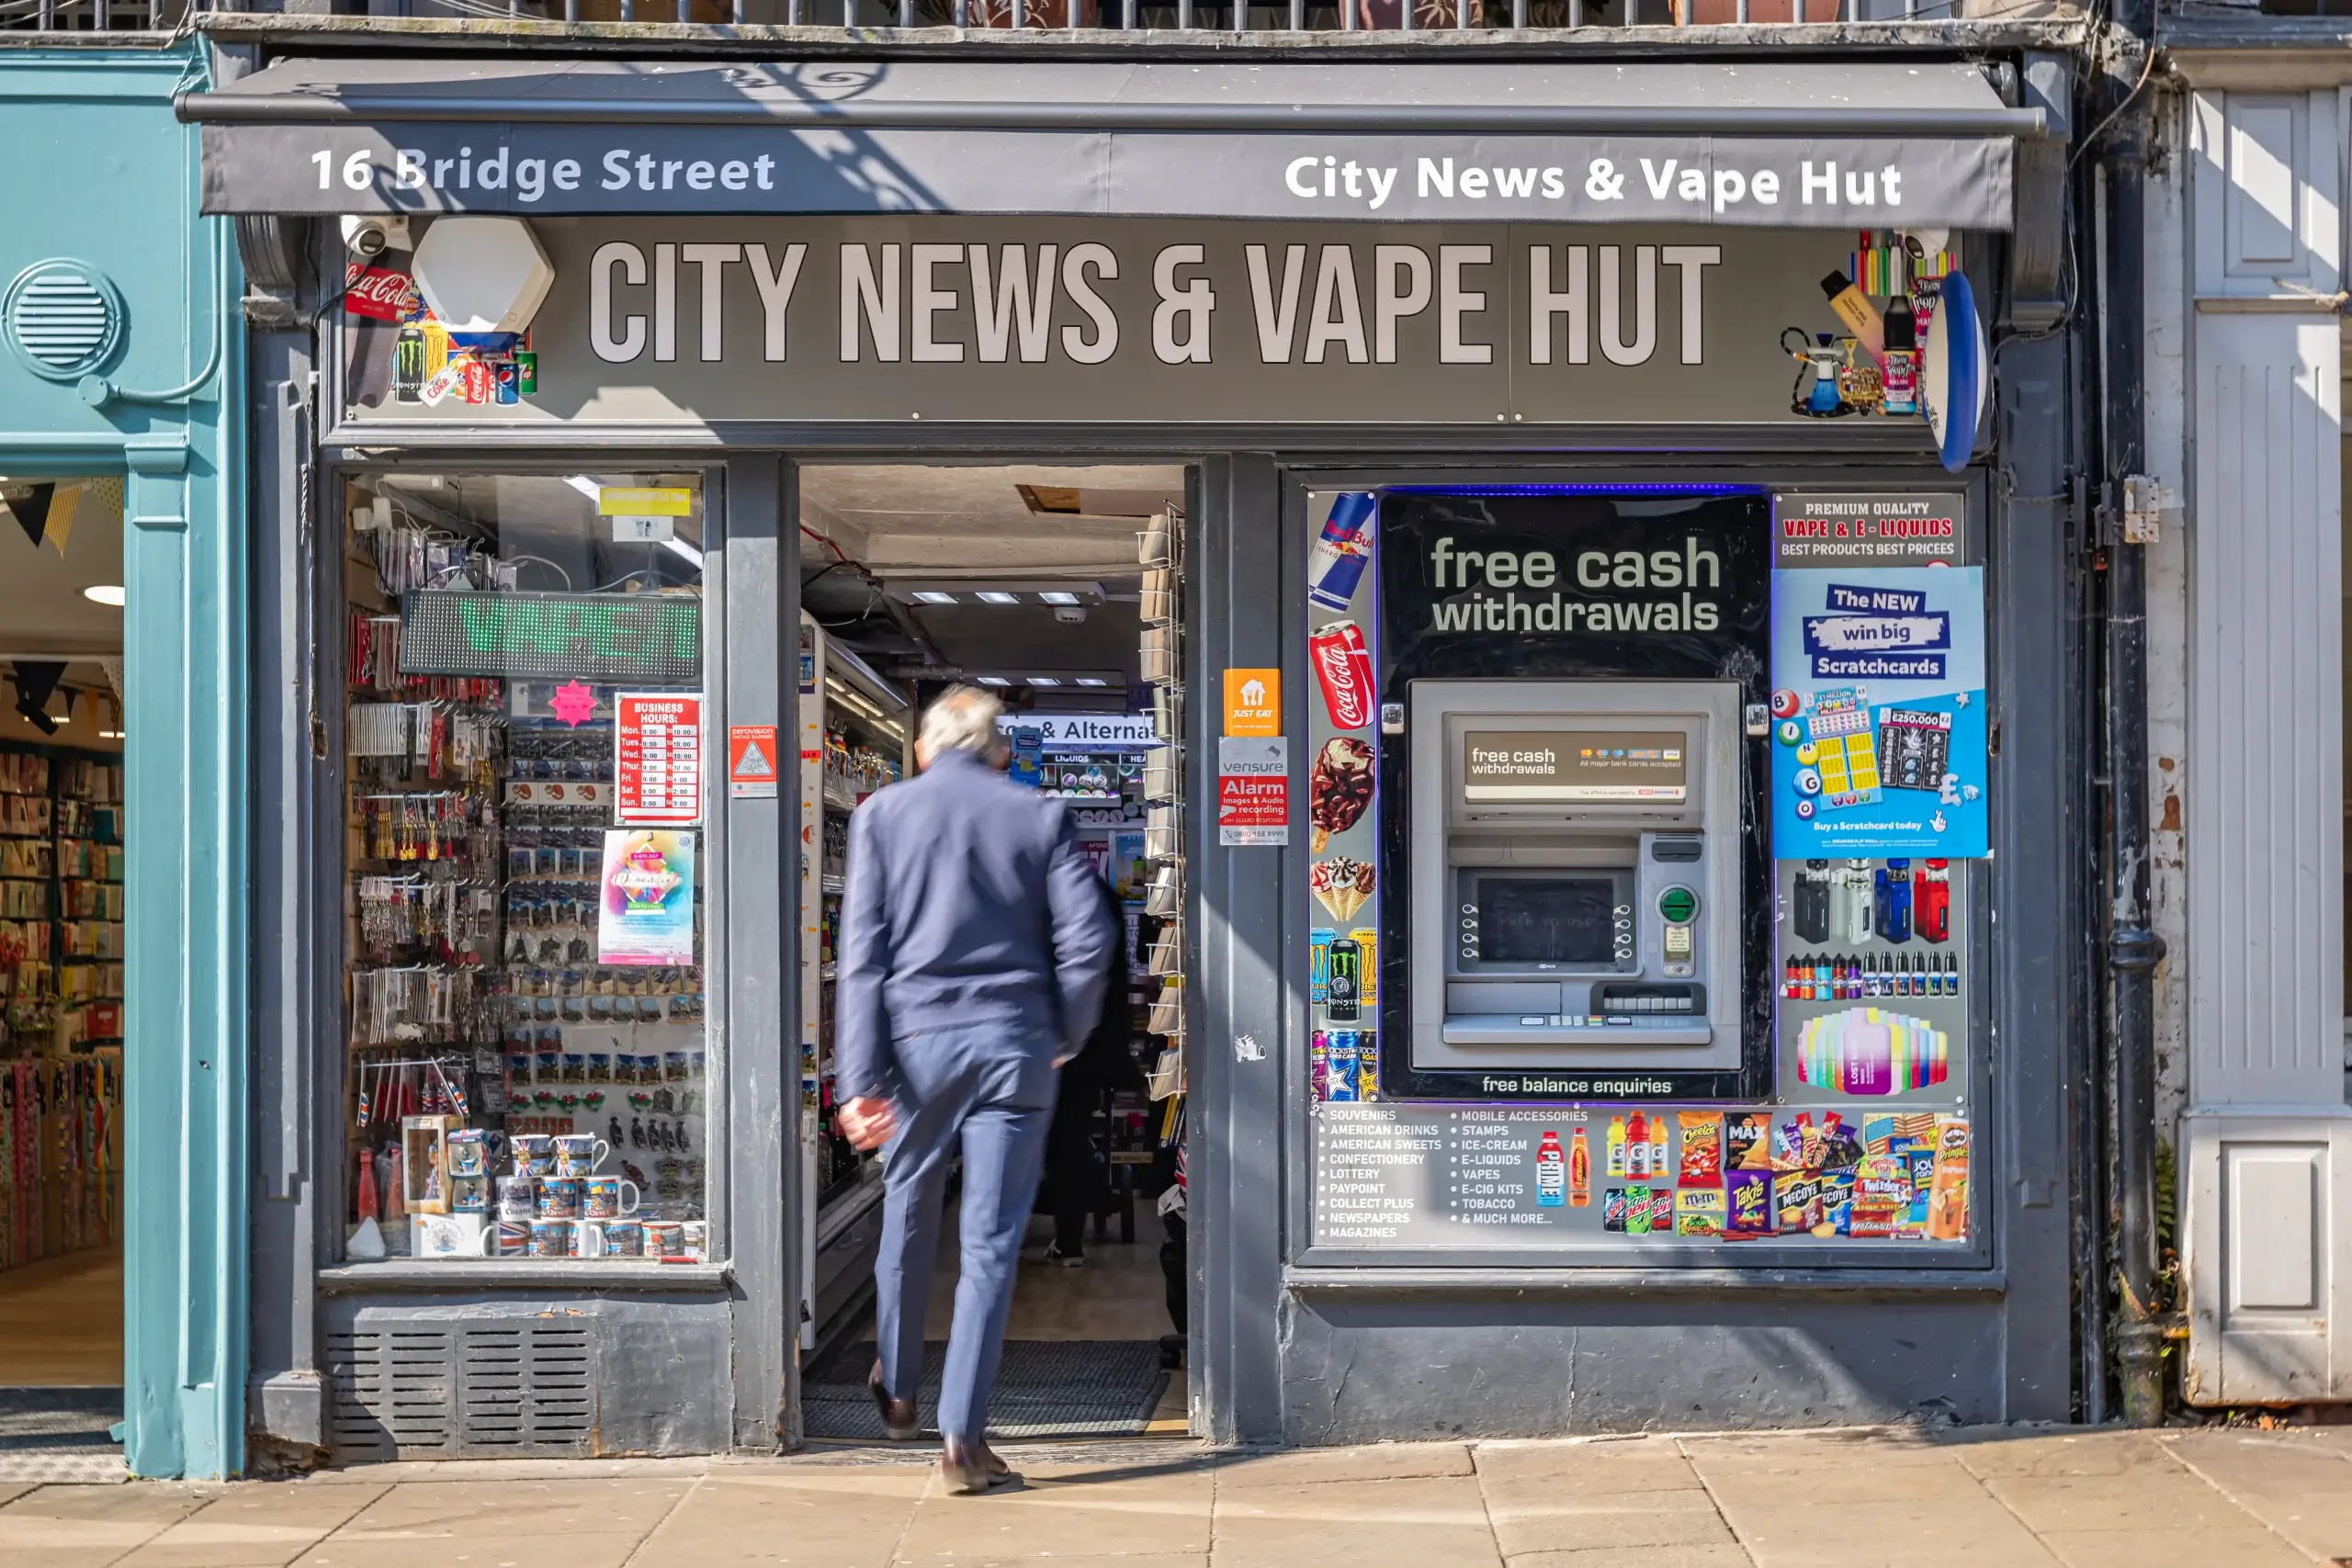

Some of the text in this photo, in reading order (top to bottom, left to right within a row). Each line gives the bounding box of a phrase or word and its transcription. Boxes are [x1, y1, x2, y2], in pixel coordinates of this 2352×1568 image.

[310, 148, 776, 202] 16 Bridge Street
[1285, 156, 1902, 214] City News & Vape Hut
[589, 240, 1723, 367] CITY NEWS & VAPE HUT
[427, 378, 450, 399] Coke
[1805, 502, 1929, 515] PREMIUM QUALITY
[1325, 519, 1374, 549] Red Bull
[1782, 518, 1828, 538] VAPE
[1836, 520, 1849, 538] &
[1855, 518, 1866, 538] E
[1879, 518, 1952, 539] LIQUIDS
[1781, 543, 1954, 556] BEST PRODUCTS BEST PRICEES
[1430, 536, 1720, 589] free cash
[1834, 589, 1919, 612] The NEW
[1431, 592, 1719, 631] withdrawals
[1843, 624, 1911, 642] win big
[1817, 657, 1939, 675] Scratchcards
[635, 704, 683, 712] BUSINESS
[1773, 695, 1784, 709] B
[641, 715, 678, 723] HOURS:
[1892, 713, 1939, 726] £250,000
[621, 726, 639, 734] Mon.
[1042, 721, 1056, 739] &
[1803, 744, 1811, 752] N
[1472, 748, 1555, 762] free cash
[1224, 761, 1283, 773] verisure
[1472, 762, 1555, 774] withdrawals
[1589, 760, 1610, 768] major
[1649, 760, 1680, 768] accepted
[1224, 780, 1283, 795] Alarm
[1805, 777, 1818, 790] G
[1239, 806, 1283, 815] recording
[1801, 804, 1810, 814] O
[1814, 821, 1832, 832] Buy
[1839, 821, 1894, 831] Scratchcard
[1895, 821, 1922, 832] today
[1850, 1061, 1859, 1085] LOST
[1483, 1076, 1672, 1097] free balance enquiries
[1330, 1111, 1396, 1120] SOUVENIRS
[1462, 1111, 1588, 1121] MOBILE ACCESSORIES
[1330, 1125, 1439, 1135] AMERICAN DRINKS
[1462, 1126, 1509, 1135] STAMPS
[1682, 1123, 1716, 1145] Cheetos
[1729, 1126, 1766, 1140] MAX
[1330, 1140, 1442, 1150] AMERICAN SWEETS
[1462, 1141, 1527, 1150] ICE-CREAM
[1330, 1155, 1425, 1165] CONFECTIONERY
[1462, 1156, 1521, 1166] E-LIQUIDS
[1938, 1146, 1968, 1164] Pringles
[1330, 1169, 1380, 1179] LOTTERY
[1463, 1170, 1500, 1179] VAPES
[1541, 1151, 1560, 1198] PRIME
[1330, 1184, 1385, 1194] PAYPOINT
[1462, 1185, 1523, 1194] E-CIG KITS
[1733, 1181, 1764, 1210] Takis
[1330, 1199, 1414, 1209] COLLECT PLUS
[1463, 1199, 1515, 1209] TOBACCO
[1330, 1213, 1410, 1224] NEWSPAPERS
[1462, 1214, 1470, 1224] &
[1474, 1214, 1512, 1224] MUCH
[1330, 1228, 1396, 1237] MAGAZINES
